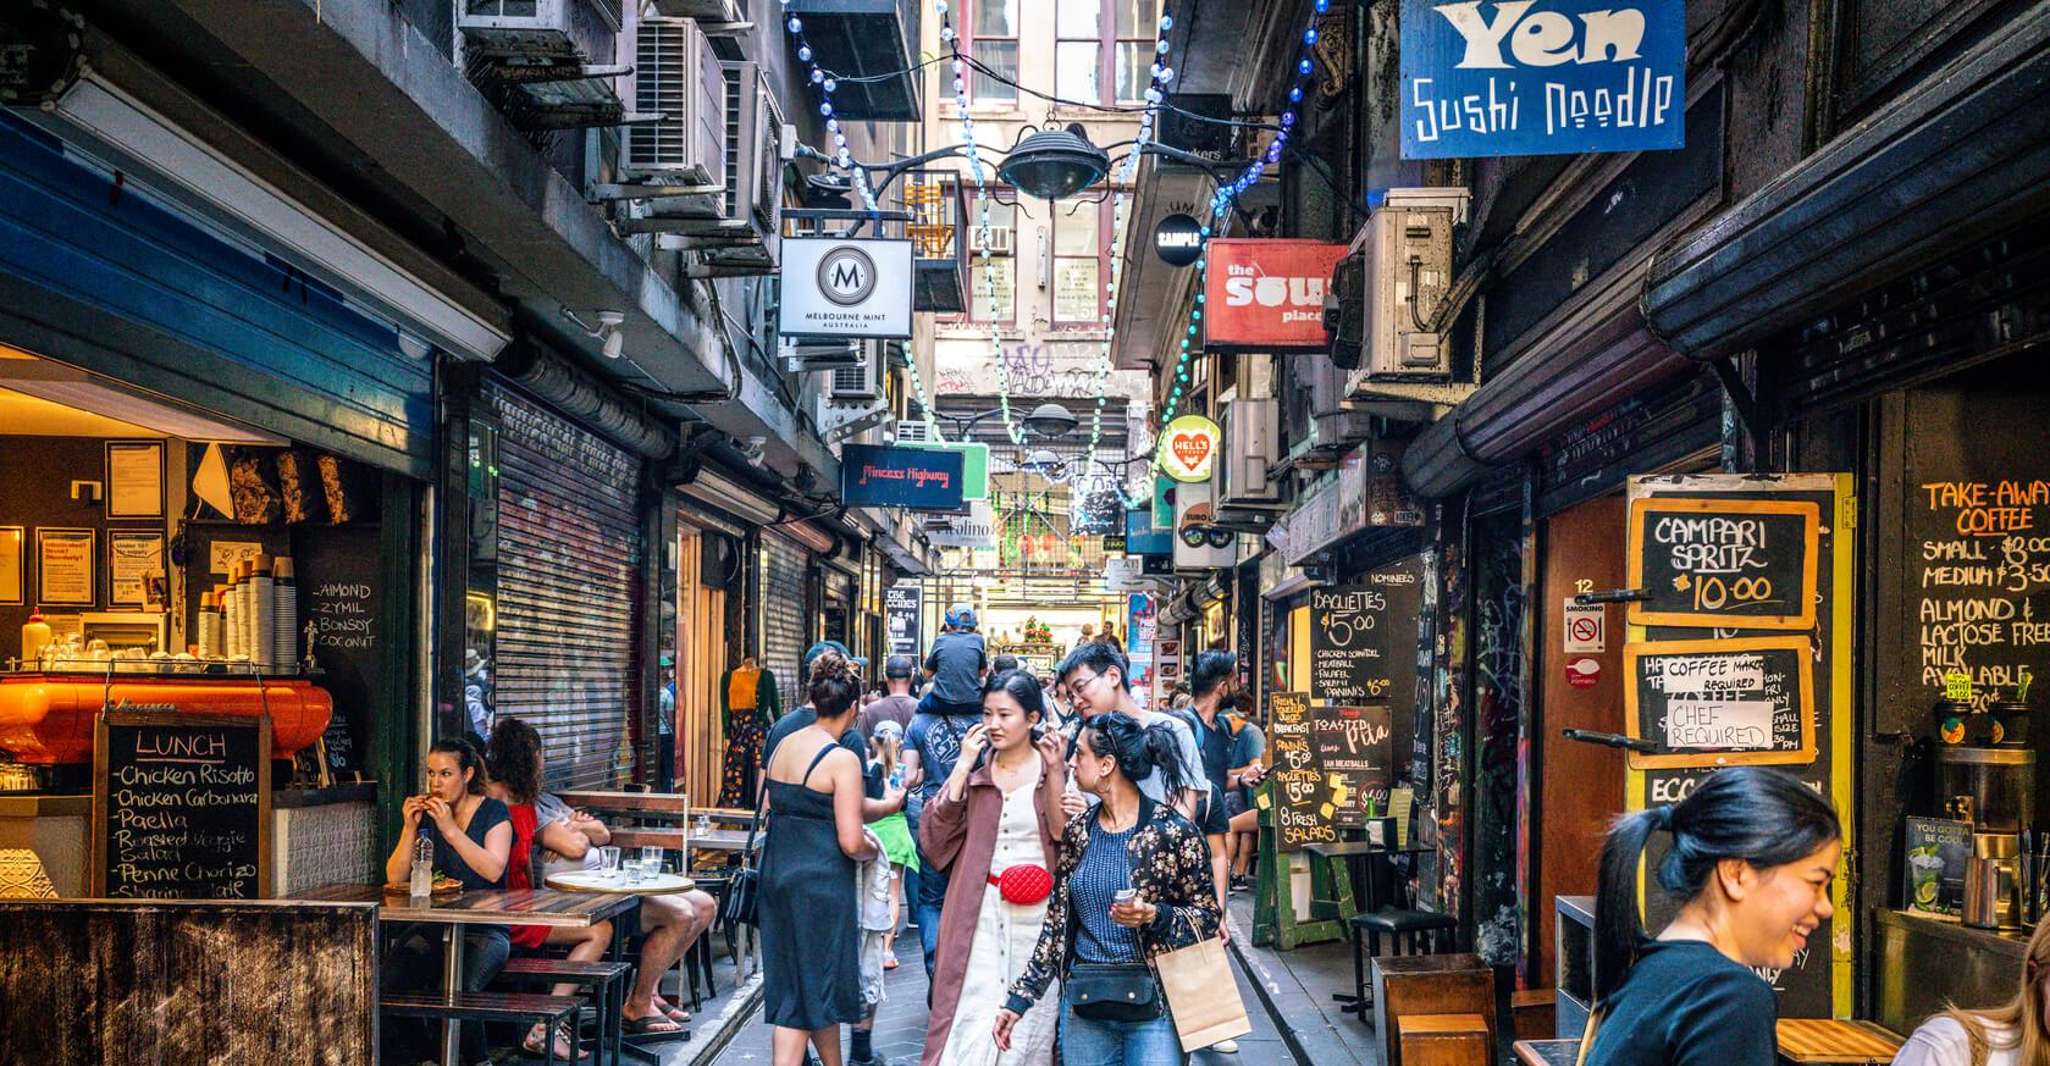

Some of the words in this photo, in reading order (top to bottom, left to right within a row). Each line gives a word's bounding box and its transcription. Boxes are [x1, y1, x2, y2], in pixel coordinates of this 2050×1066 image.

[1432, 0, 1646, 68] Yen
[1413, 77, 1519, 141] Sushi
[1157, 231, 1201, 247] SAMPLE
[833, 262, 860, 288] M
[1227, 263, 1255, 277] the
[805, 312, 860, 321] MELBOURNE
[859, 465, 905, 485] Princess
[907, 466, 949, 489] Highway
[1956, 507, 2033, 536] COFFEE
[1655, 516, 1766, 549] CAMPARI
[1671, 544, 1769, 572] SPRITZ
[1923, 540, 1988, 560] SMALL
[1574, 579, 1594, 593] 12
[1922, 566, 1993, 588] MEDIUM
[1313, 589, 1387, 611] BAGUETTES
[1920, 598, 2015, 623] ALMOND
[320, 617, 374, 635] BONSOY
[1921, 621, 2005, 648] LACTOSE
[2012, 622, 2050, 646] FREE
[320, 634, 377, 649] COCONUT
[1317, 650, 1348, 659] CHICKEN
[1318, 659, 1355, 669] MEATBALL
[1922, 646, 1967, 668] MILK
[1318, 669, 1351, 678] FALAFEL
[1668, 659, 1728, 677] COFFEE
[1704, 678, 1756, 691] REQUIRED
[1765, 684, 1782, 696] FRI
[1314, 719, 1368, 731] TOASTED
[1672, 705, 1724, 728] CHEF
[1774, 713, 1799, 724] MALL
[135, 730, 227, 757] LUNCH
[1671, 726, 1766, 746] REQUIRED
[1782, 740, 1799, 750] PM
[200, 764, 256, 785] Risotto
[185, 788, 259, 807] Carbonara
[1280, 806, 1292, 826] 8
[1291, 811, 1318, 826] FRESH
[1284, 825, 1337, 844] SALADS
[1916, 824, 1936, 833] YOU
[1925, 834, 1936, 842] BE
